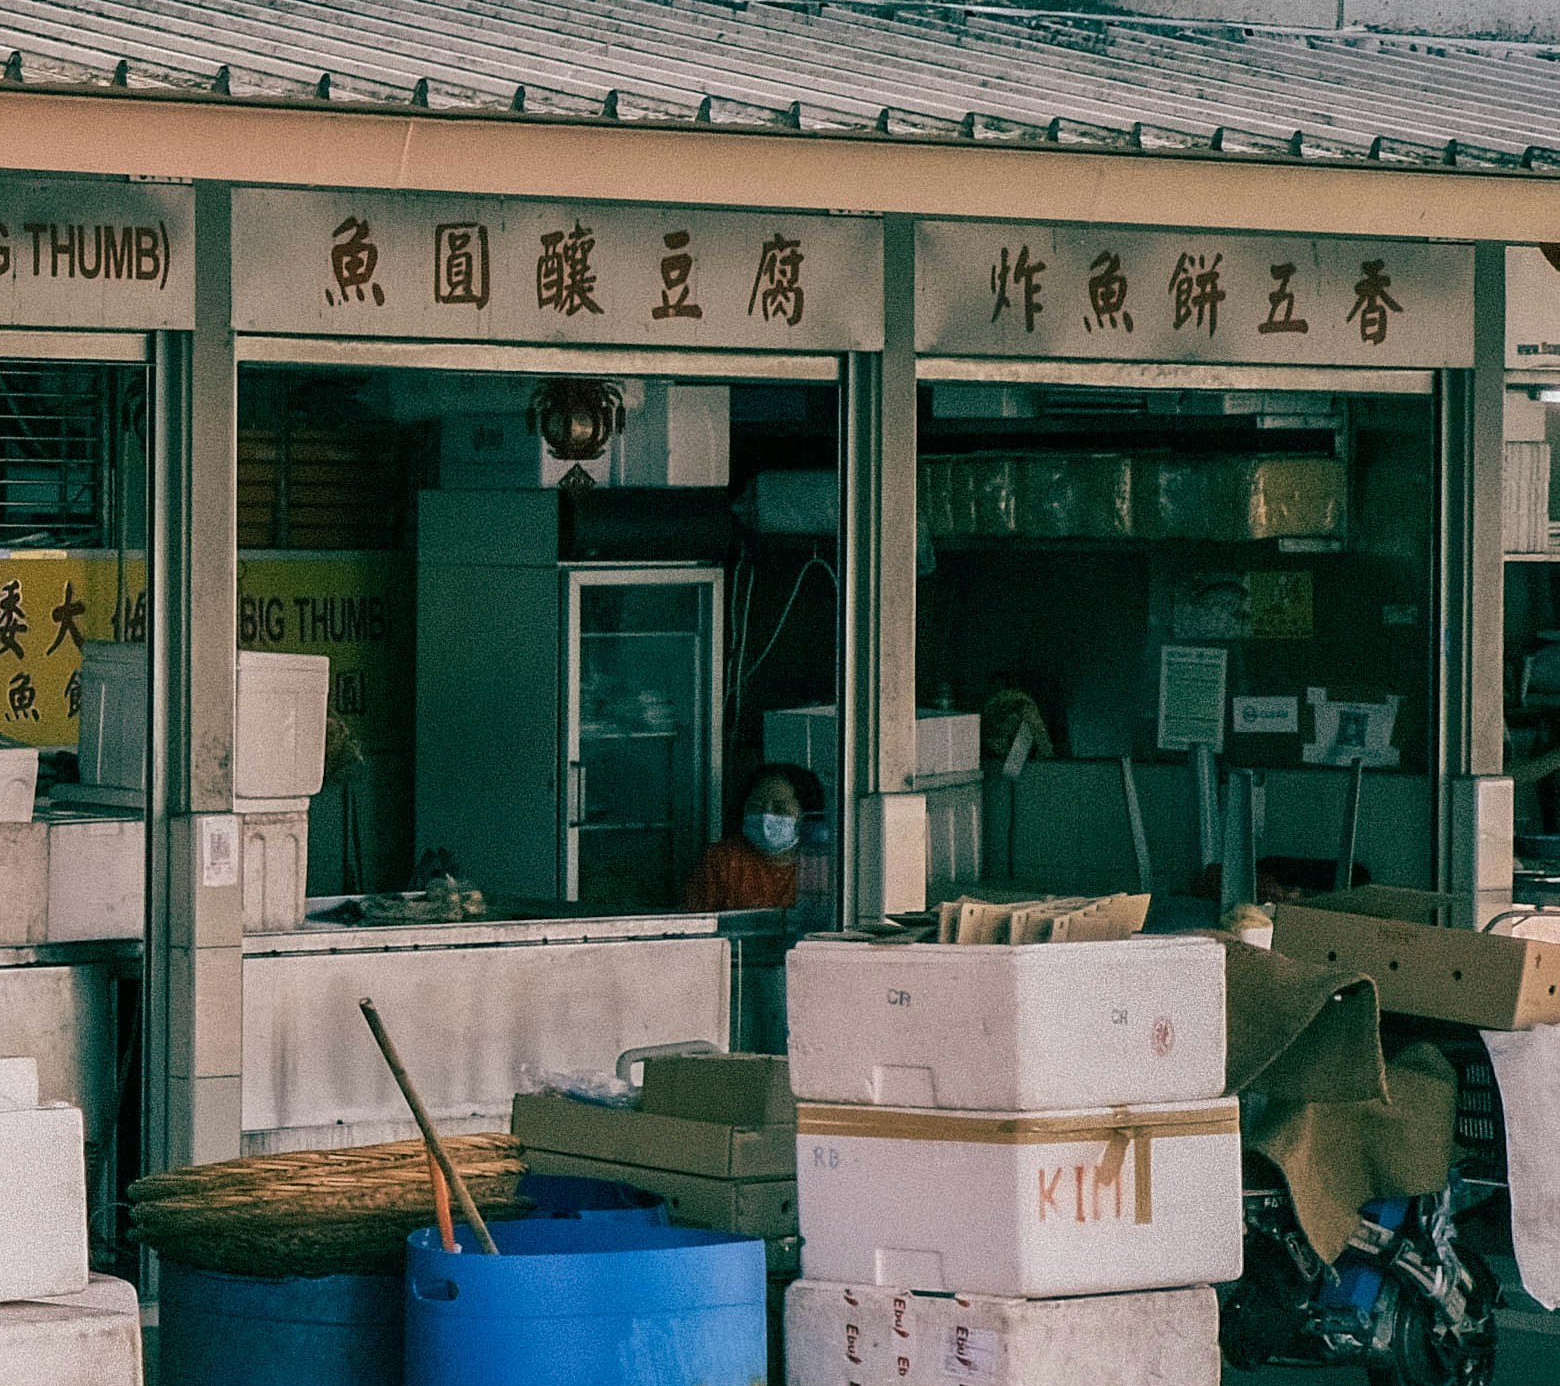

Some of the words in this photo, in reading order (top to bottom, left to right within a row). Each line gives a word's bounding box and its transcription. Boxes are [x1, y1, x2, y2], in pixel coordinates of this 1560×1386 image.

[23, 219, 171, 291] THUMB)
[323, 218, 807, 327] 魚圓釀豆腐
[990, 245, 1405, 347] 炸魚餅五香
